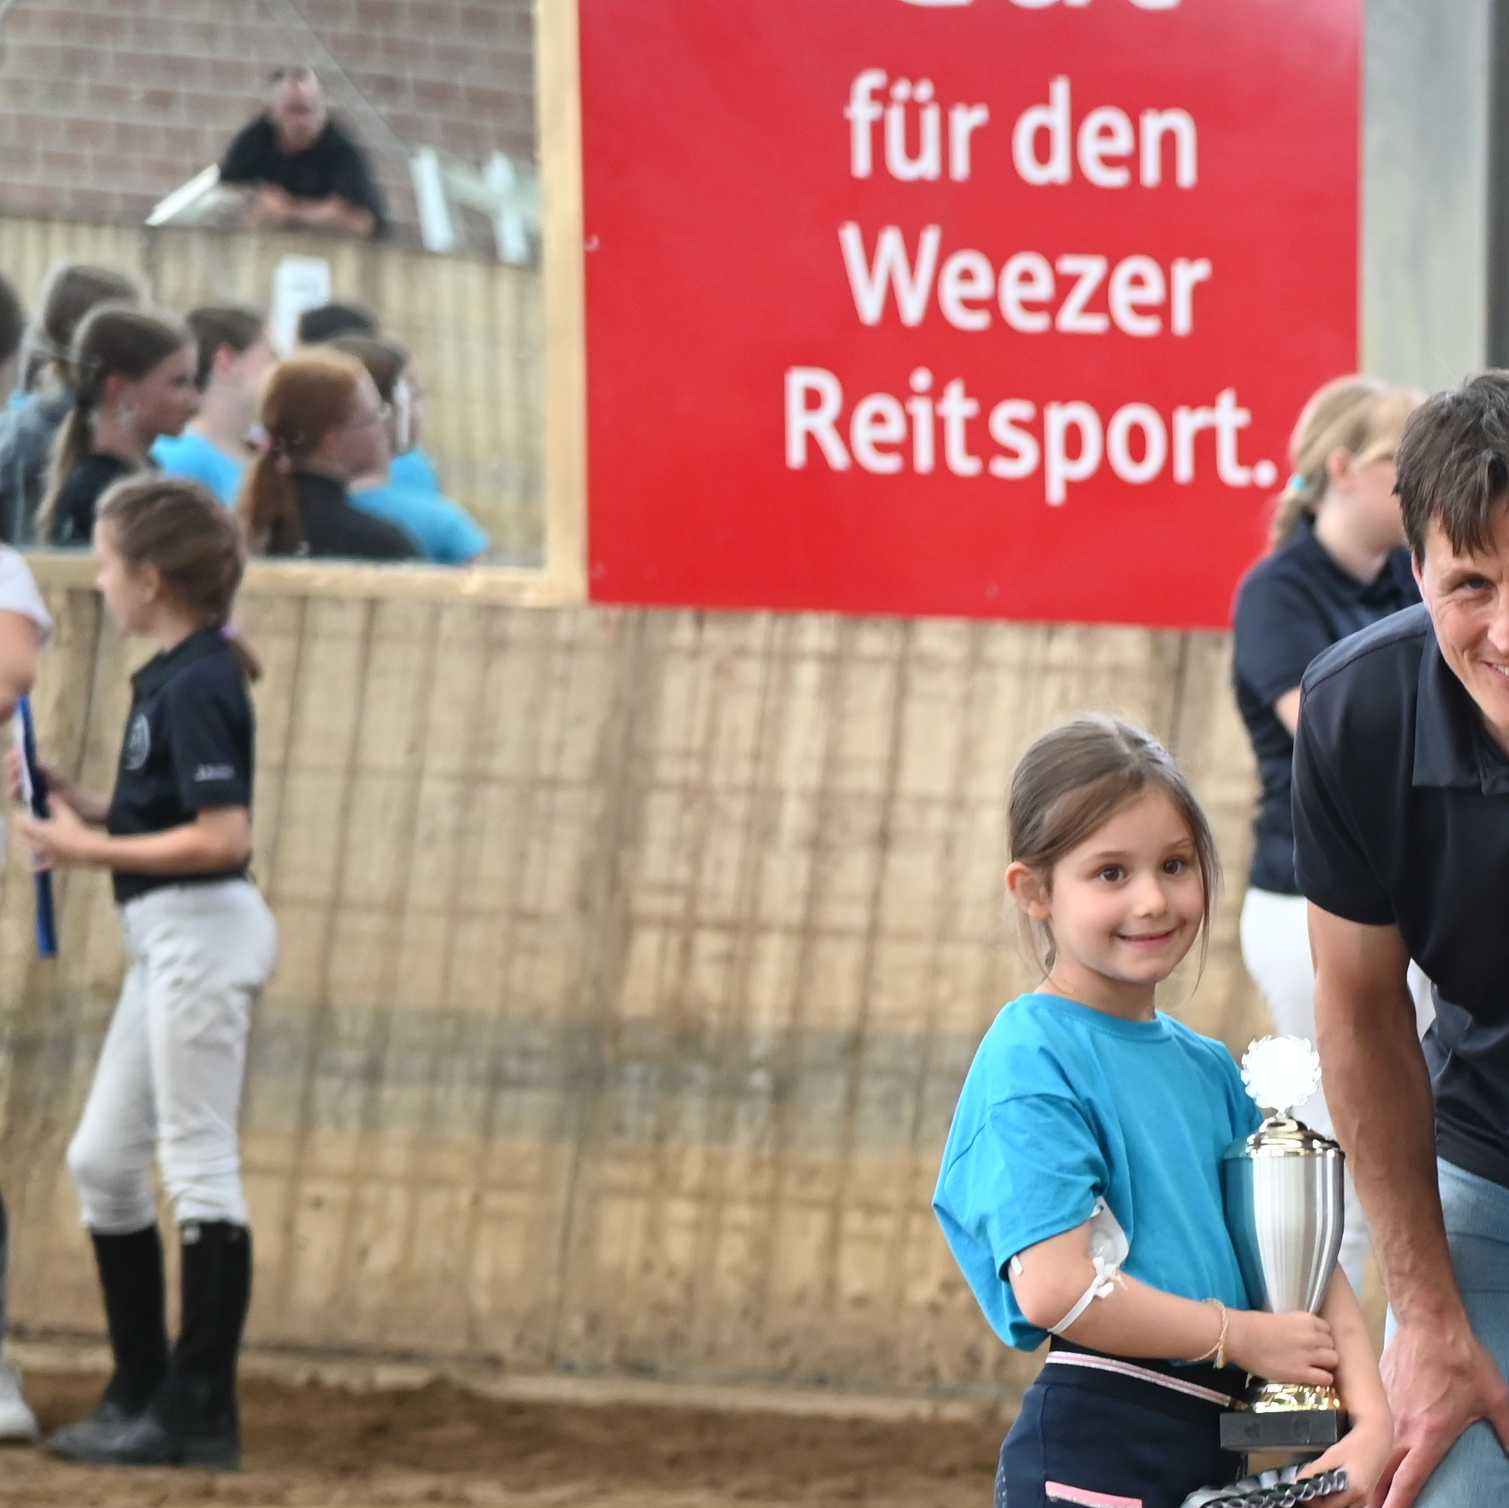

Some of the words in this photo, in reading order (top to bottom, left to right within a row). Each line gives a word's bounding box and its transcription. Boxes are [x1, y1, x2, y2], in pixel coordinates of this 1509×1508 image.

[845, 68, 990, 182] für
[1012, 74, 1198, 189] den
[838, 221, 1213, 338] Weezer
[784, 366, 1278, 507] Reitsport.
